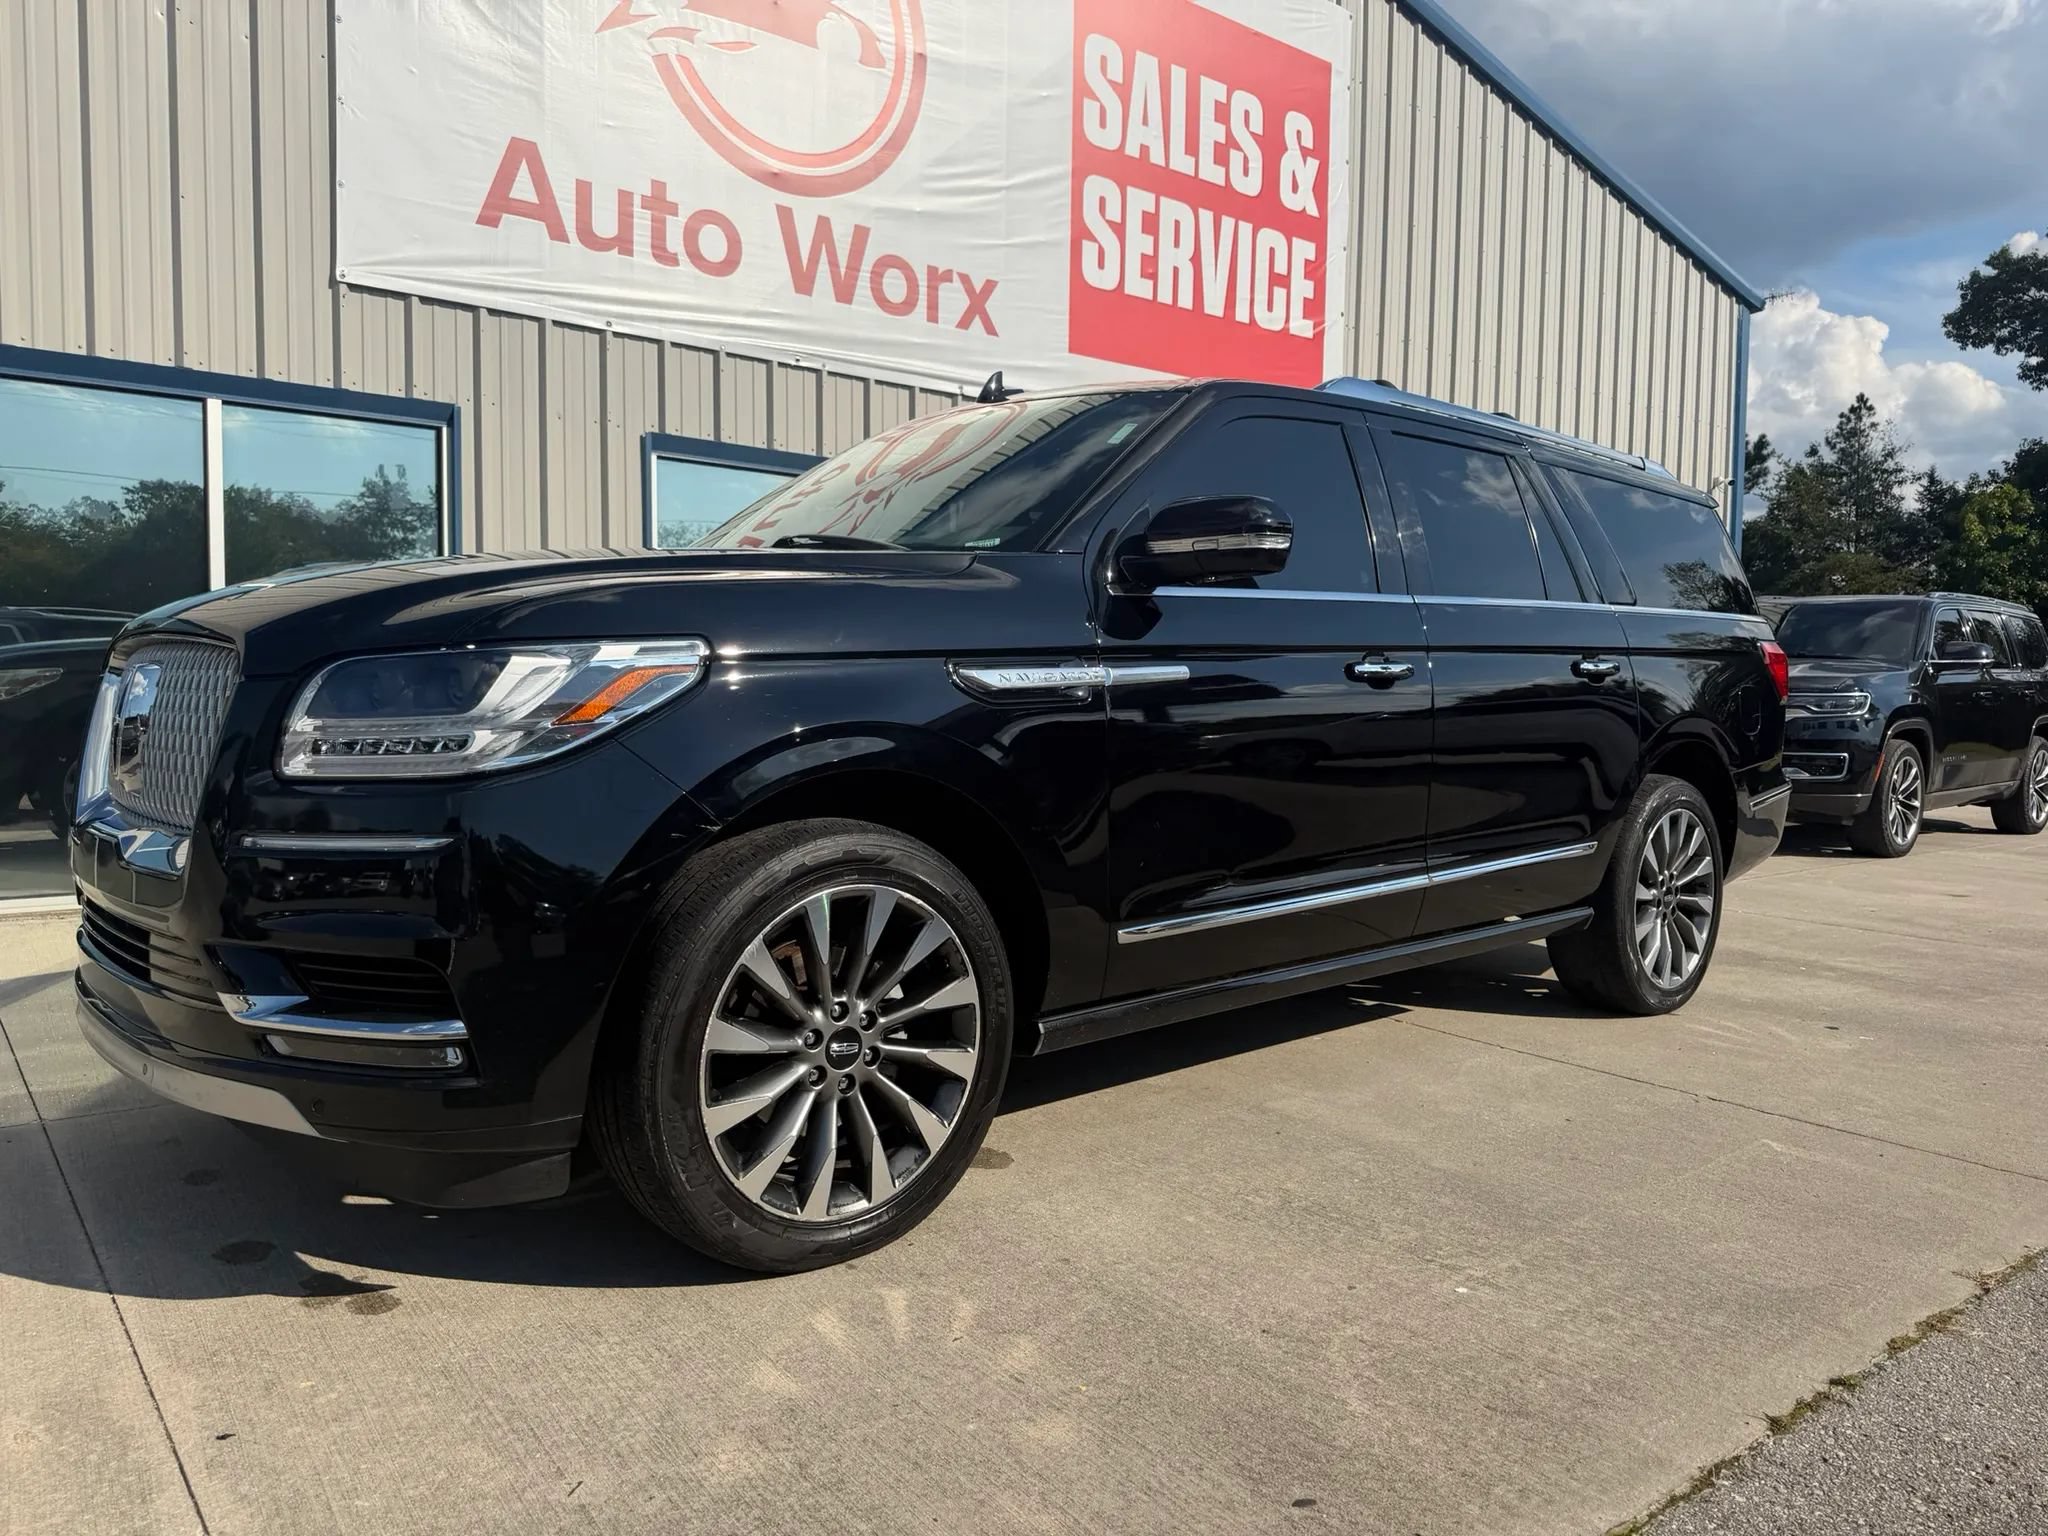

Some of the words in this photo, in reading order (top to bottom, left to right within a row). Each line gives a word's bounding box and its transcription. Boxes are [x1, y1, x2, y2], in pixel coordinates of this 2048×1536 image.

[1083, 33, 1264, 197] SALES
[1279, 110, 1320, 218] &
[475, 136, 743, 278] Auto
[775, 203, 1000, 337] Worx
[1081, 174, 1316, 339] SERVICE
